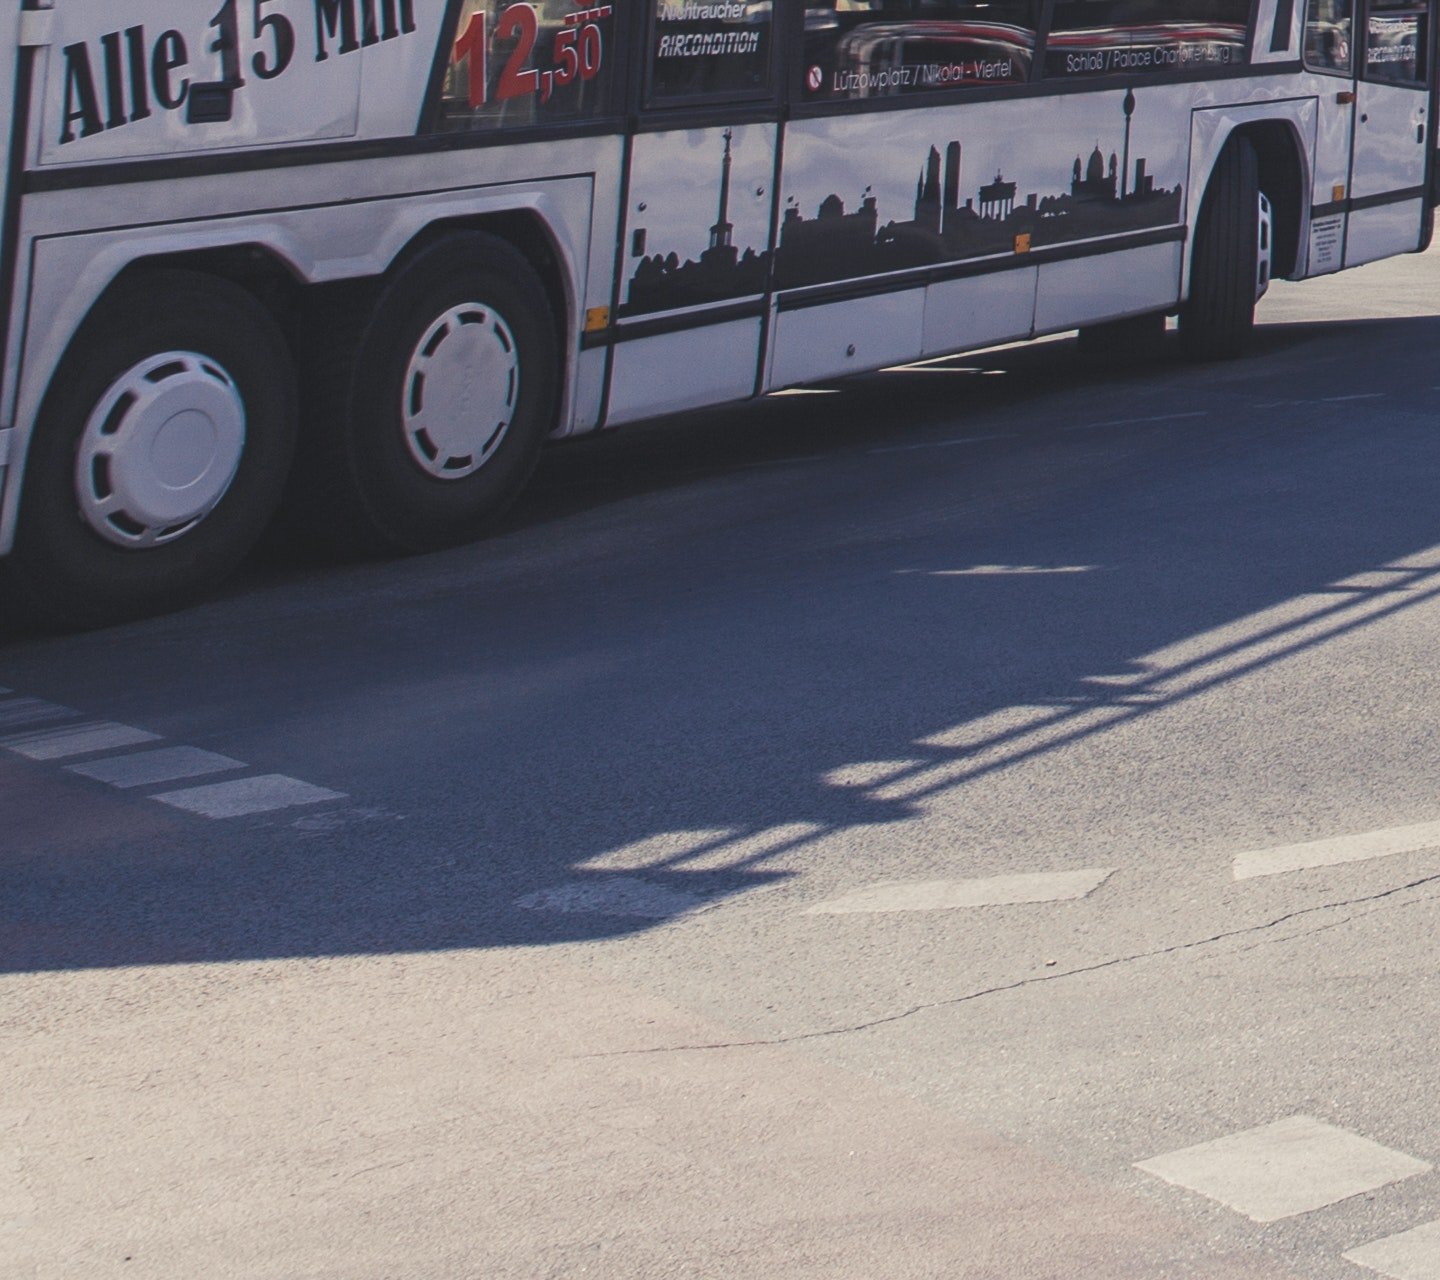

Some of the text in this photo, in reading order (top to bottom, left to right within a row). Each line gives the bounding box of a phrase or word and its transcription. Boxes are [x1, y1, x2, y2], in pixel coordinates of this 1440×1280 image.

[660, 0, 747, 22] Nichtraucher
[452, 1, 602, 108] 12,50
[657, 31, 760, 58] AIRCONDITION
[1067, 51, 1103, 73] Schloß
[1113, 48, 1150, 69] Palace
[1153, 44, 1230, 65] Charlottenburg
[59, 24, 190, 145] Alle
[833, 64, 910, 92] Lützowplatz
[923, 62, 964, 83] Nikolai
[973, 57, 1013, 79] Viertel
